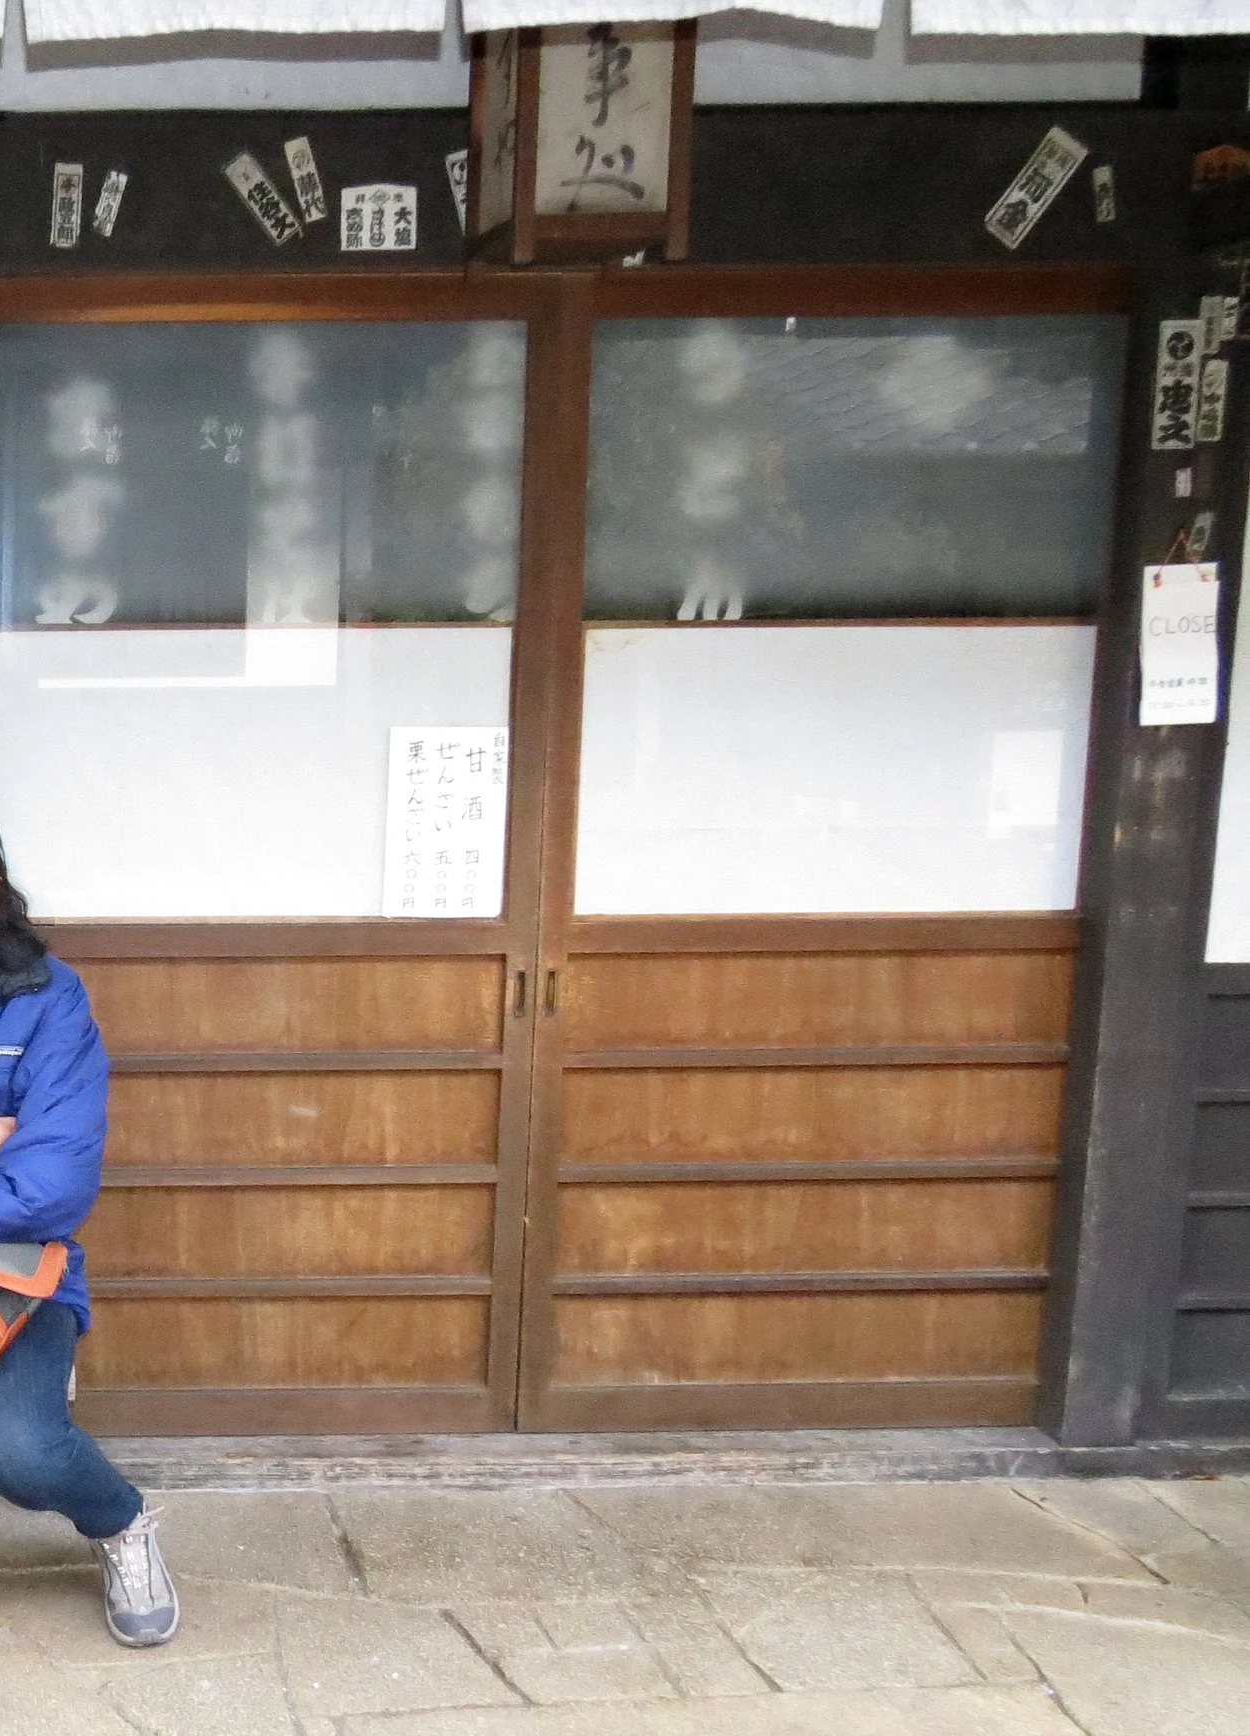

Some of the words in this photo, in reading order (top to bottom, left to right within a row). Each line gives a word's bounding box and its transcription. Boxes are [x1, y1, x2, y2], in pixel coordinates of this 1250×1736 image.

[1149, 615, 1216, 637] CLOSE
[405, 740, 429, 842] 栗ぜんざい
[435, 742, 461, 832] ぜんざい
